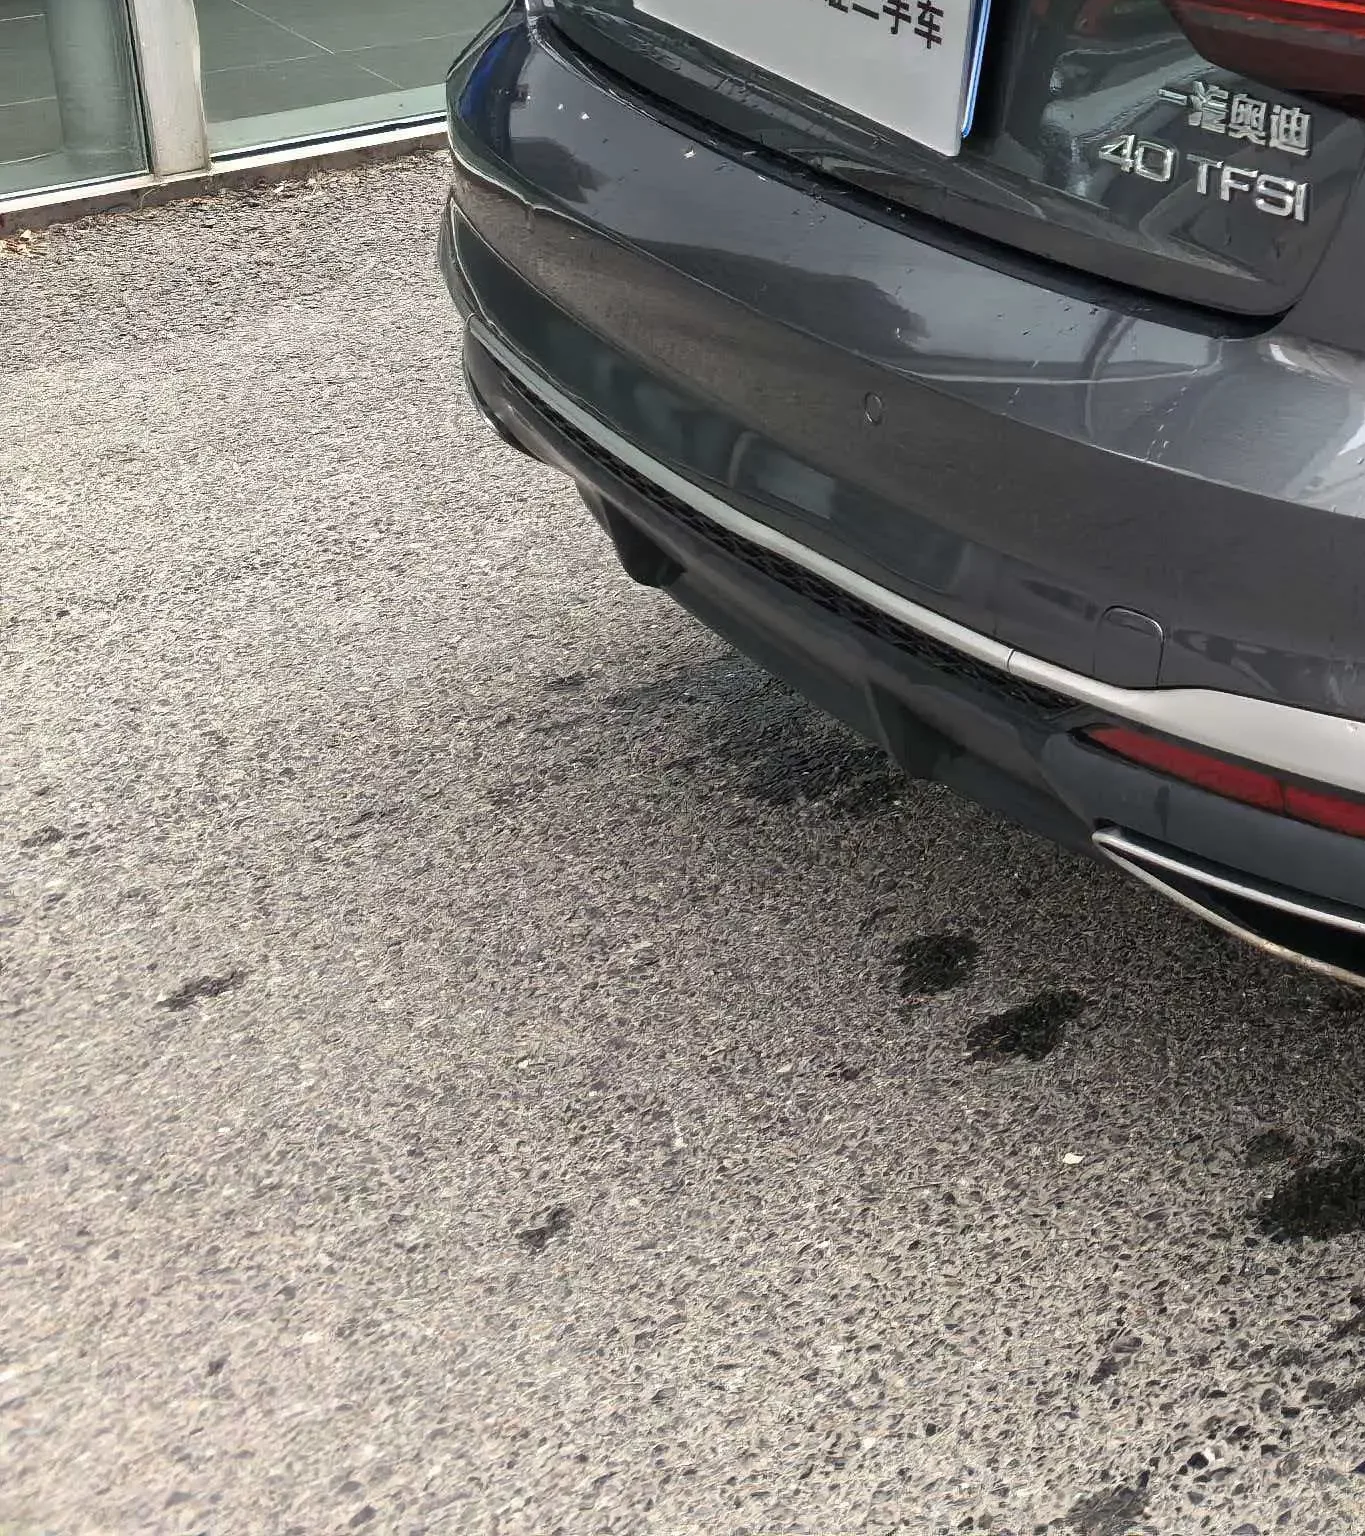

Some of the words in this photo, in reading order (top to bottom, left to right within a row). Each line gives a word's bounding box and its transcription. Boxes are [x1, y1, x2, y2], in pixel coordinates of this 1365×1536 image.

[1157, 81, 1312, 157] 一汽奥迪
[1098, 134, 1177, 183] 40
[1186, 153, 1309, 222] TFSI
